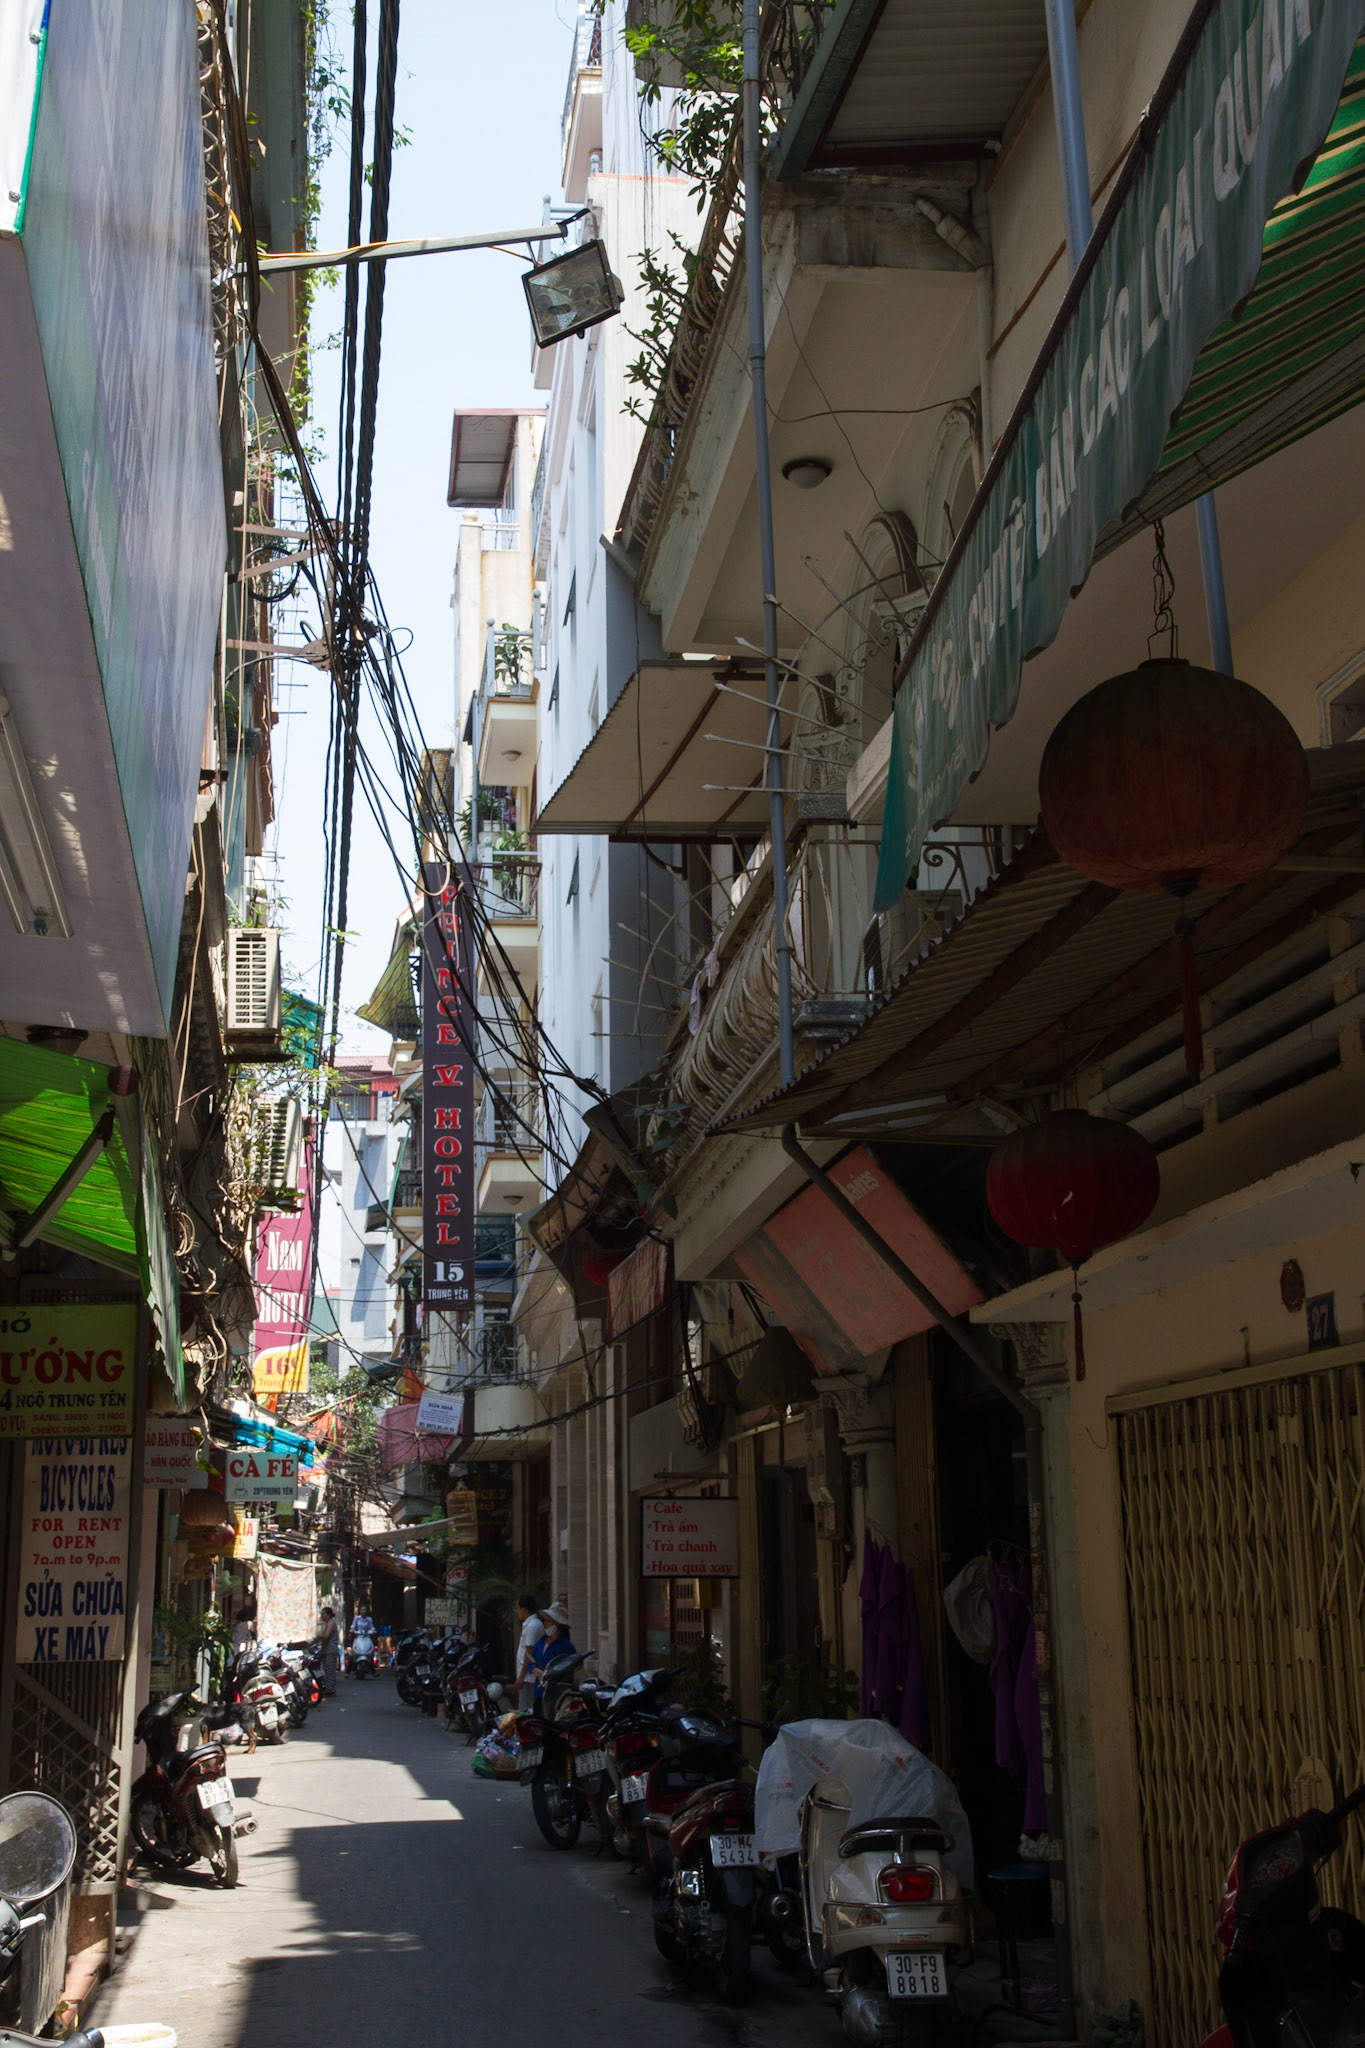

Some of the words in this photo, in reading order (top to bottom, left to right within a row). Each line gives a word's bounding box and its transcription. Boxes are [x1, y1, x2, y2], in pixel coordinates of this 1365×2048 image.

[968, 495, 1023, 681] CHUYÊ
[1080, 285, 1130, 457] CÁC
[436, 884, 463, 1046] PRINCE
[432, 1063, 465, 1087] V
[433, 1107, 463, 1245] HOTEL
[432, 1260, 465, 1282] 15
[427, 1288, 453, 1300] TRUNG
[1311, 1302, 1329, 1340] 27
[16, 1390, 46, 1408] NGÕ
[48, 1393, 96, 1408] TRUNG
[99, 1389, 127, 1407] YÊN
[158, 1428, 180, 1447] HÀNG
[181, 1430, 199, 1450] KIỆ
[229, 1454, 260, 1478] CÀ
[267, 1454, 295, 1478] FÉ
[40, 1464, 116, 1513] BICYCLES
[653, 1501, 683, 1514] Cafe
[32, 1518, 64, 1533] FOR
[78, 1517, 123, 1532] RENT
[652, 1520, 675, 1533] Trà
[678, 1518, 699, 1533] ấm
[53, 1535, 97, 1549] OPEN
[652, 1539, 674, 1552] Trà
[678, 1540, 718, 1553] chanh
[32, 1553, 66, 1566] 7a.m
[69, 1554, 83, 1565] to
[87, 1553, 121, 1568] 9p.m
[651, 1560, 678, 1573] Hoa
[710, 1562, 734, 1574] xay
[24, 1568, 63, 1618] SỬA
[72, 1572, 124, 1617] CHỮA
[33, 1626, 60, 1662] XE
[65, 1620, 110, 1661] MÁY
[720, 1850, 755, 1865] 5434
[895, 1955, 938, 1974] 30-F9
[896, 1975, 940, 1995] 8818
